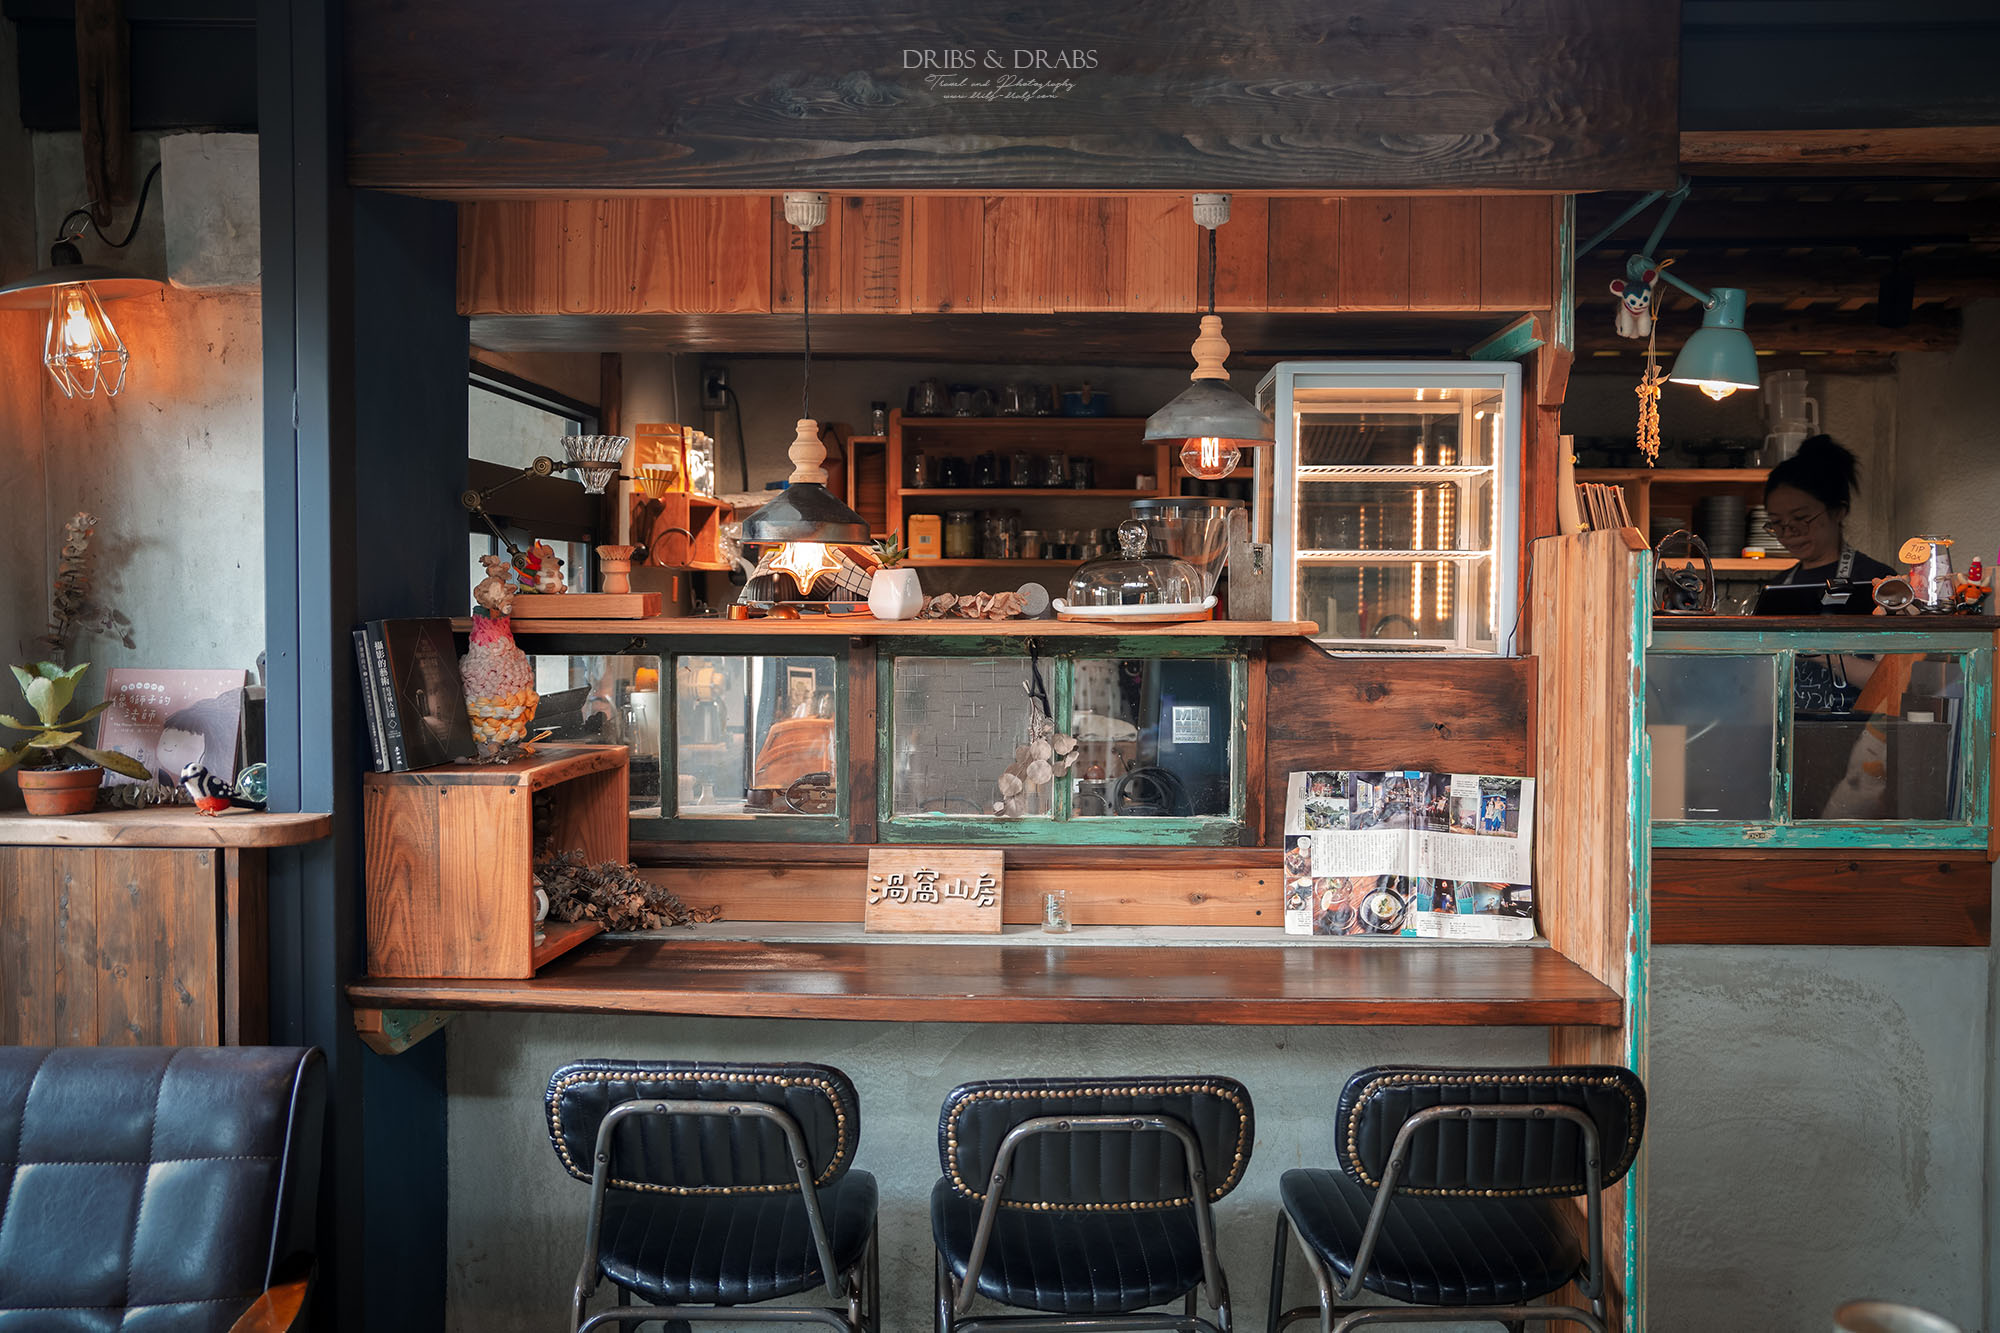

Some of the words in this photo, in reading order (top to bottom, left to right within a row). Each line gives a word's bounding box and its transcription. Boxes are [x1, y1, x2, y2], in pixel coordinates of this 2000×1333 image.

[1911, 544, 1925, 553] TIP
[868, 866, 997, 908] 渦窩山房
